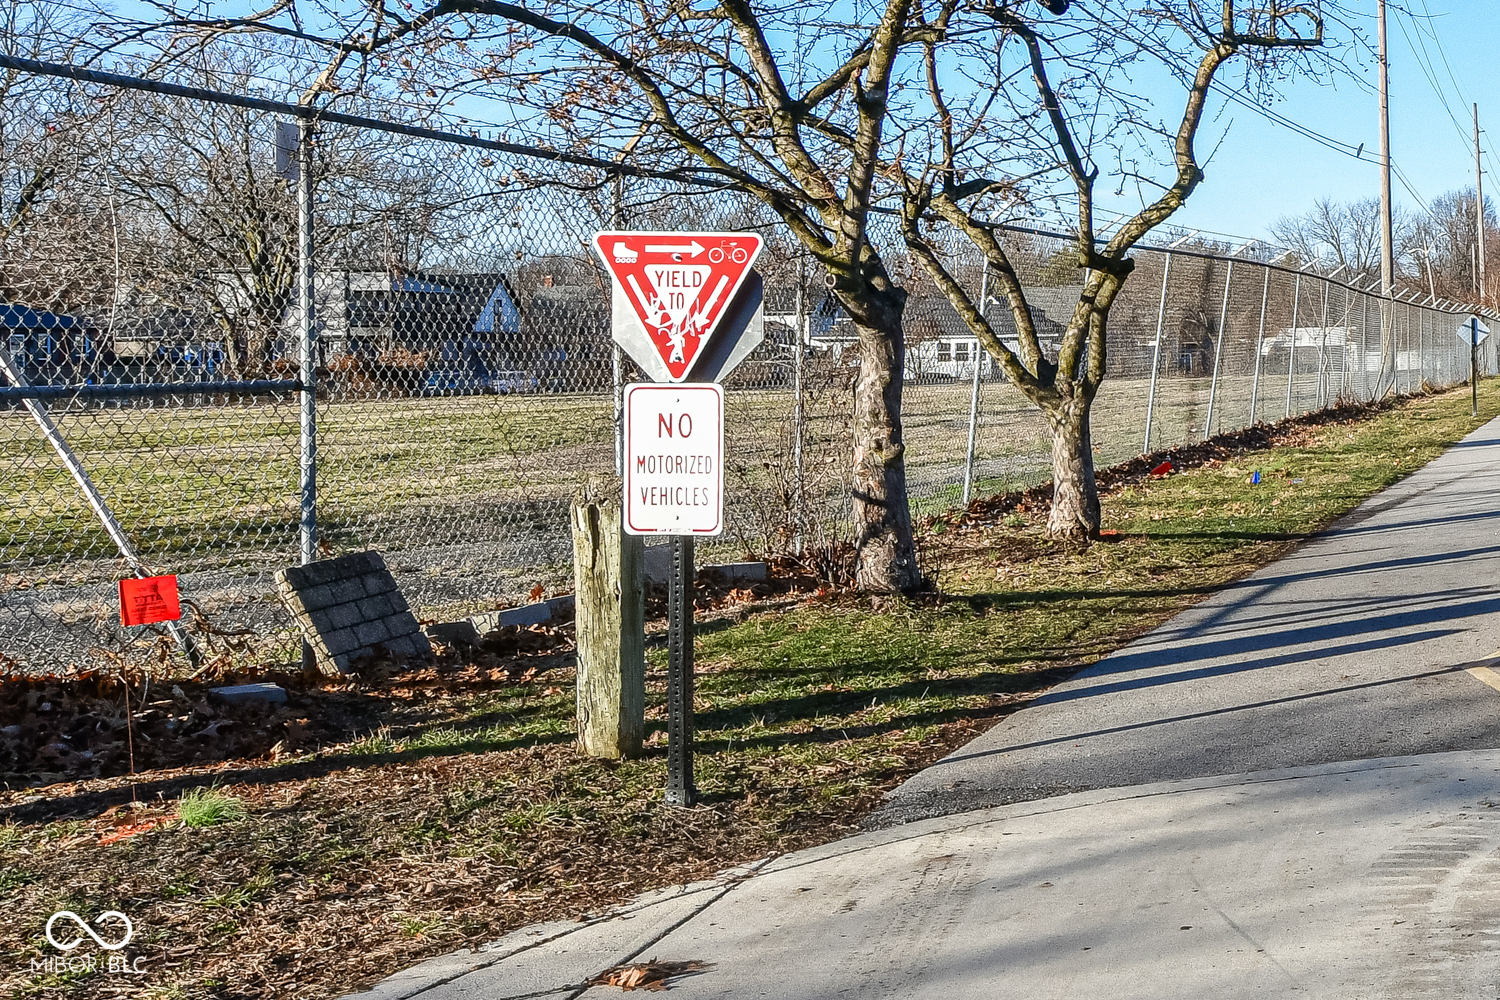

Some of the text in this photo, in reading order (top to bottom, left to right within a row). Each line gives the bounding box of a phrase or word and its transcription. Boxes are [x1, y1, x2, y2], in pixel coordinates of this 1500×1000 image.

[654, 270, 703, 288] YIELD
[668, 292, 685, 310] TO
[658, 412, 693, 439] NO
[636, 455, 712, 474] MOTORIZED
[640, 486, 709, 506] VEHICLES
